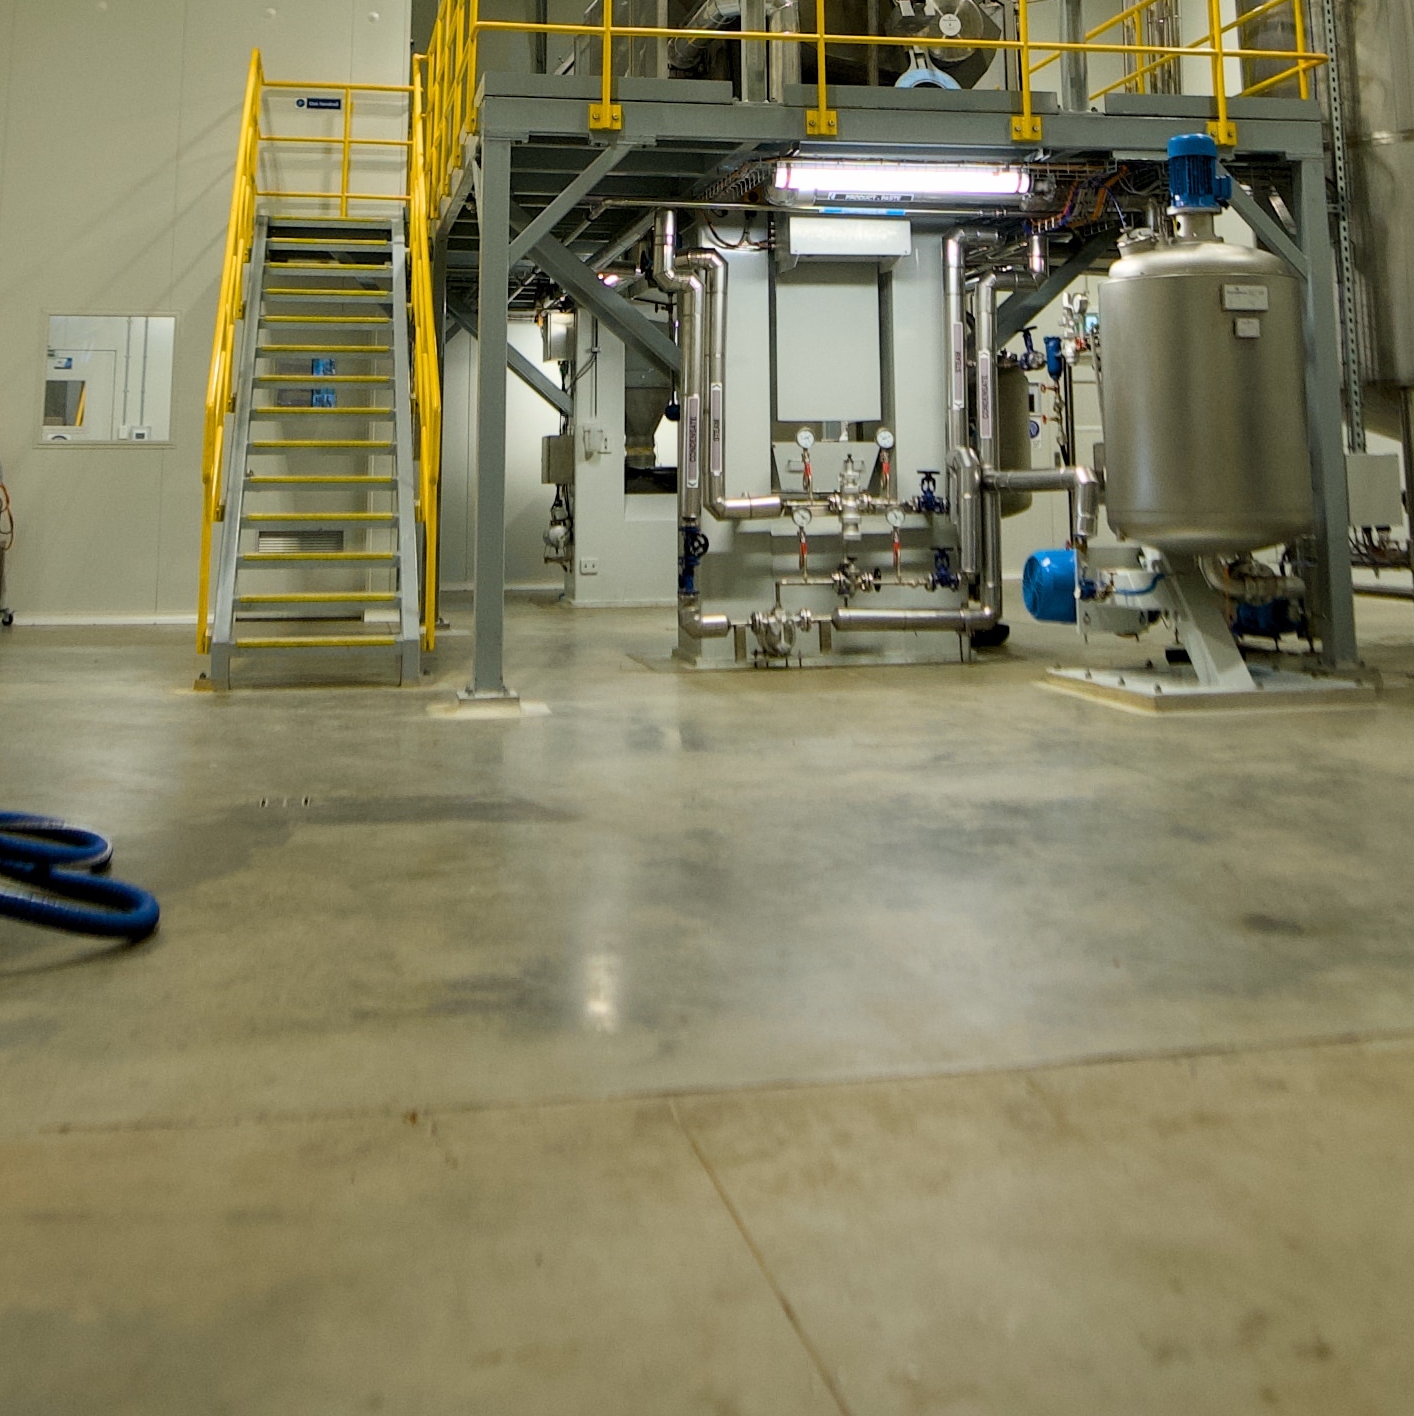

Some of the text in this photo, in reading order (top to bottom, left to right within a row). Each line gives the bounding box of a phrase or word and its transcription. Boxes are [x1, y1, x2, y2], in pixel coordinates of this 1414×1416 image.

[954, 351, 962, 373] STEAM
[981, 375, 989, 419] CONDENSATE
[689, 416, 697, 462] CONDENSATE
